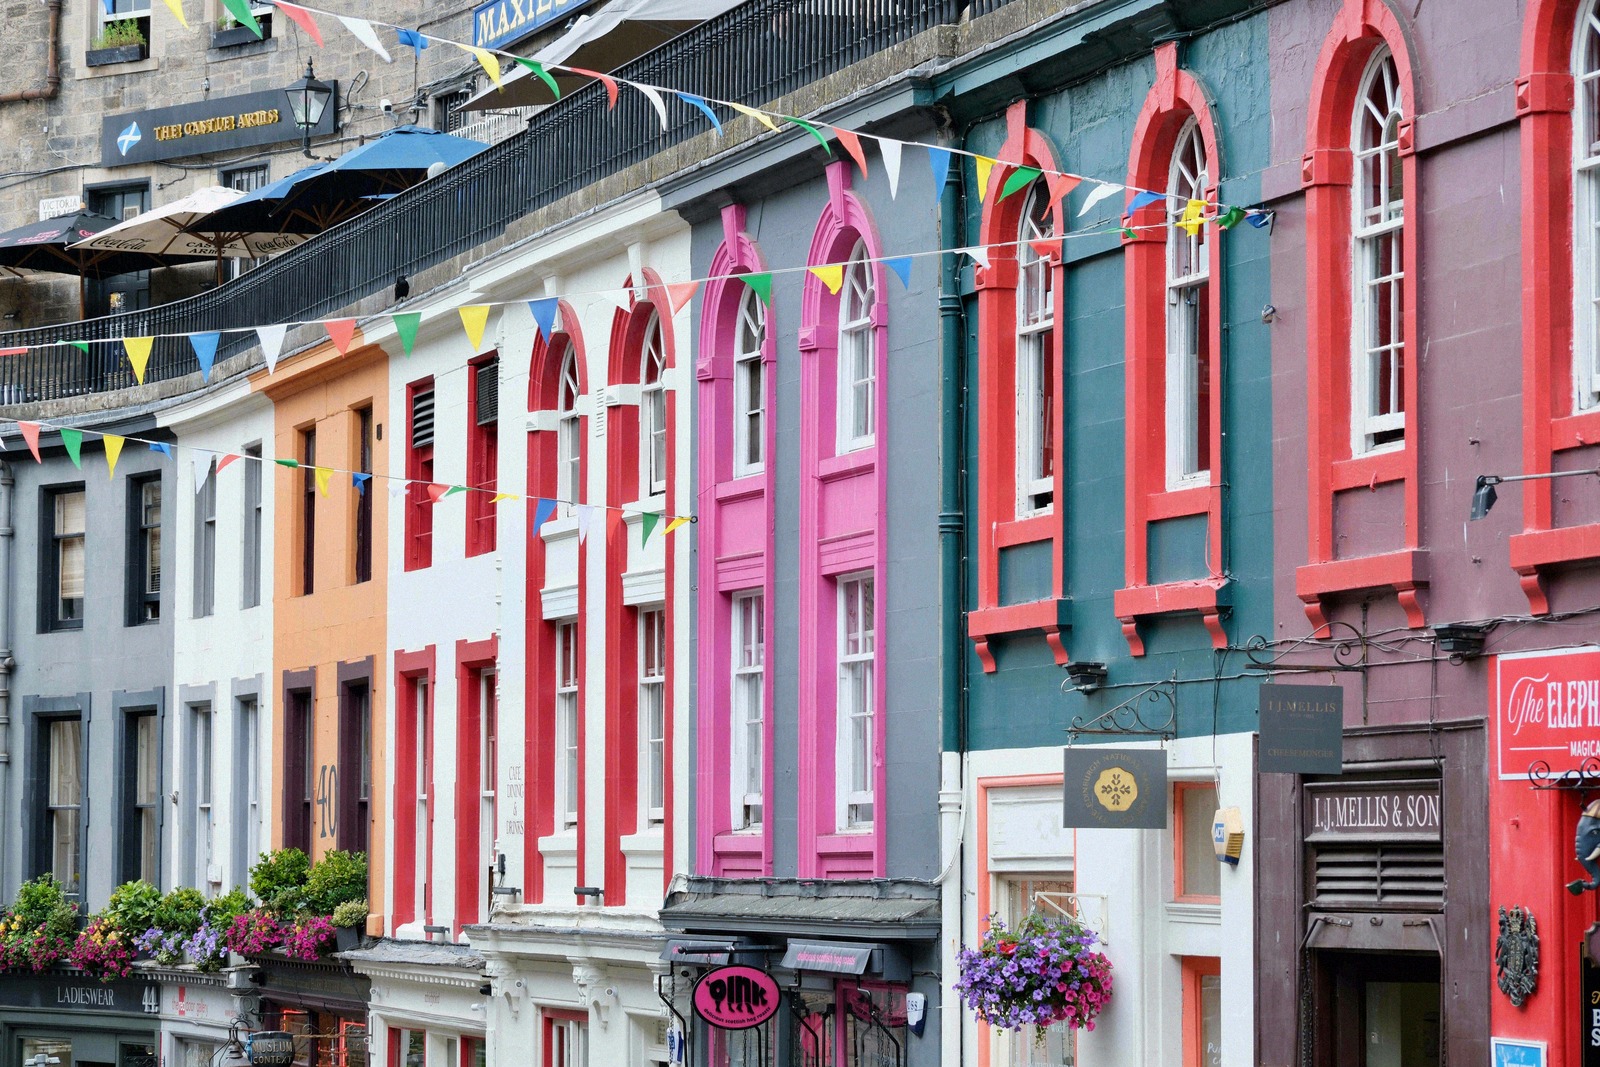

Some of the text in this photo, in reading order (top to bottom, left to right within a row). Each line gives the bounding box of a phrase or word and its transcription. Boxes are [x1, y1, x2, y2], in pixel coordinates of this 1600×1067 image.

[477, 0, 568, 46] MAXIE
[153, 124, 182, 141] THE
[184, 115, 235, 136] CASTLE
[42, 198, 78, 210] VICTORIA
[1508, 672, 1600, 736] The ELEPH
[506, 783, 524, 798] DINING
[316, 764, 338, 838] 40
[512, 801, 518, 816] &
[1392, 795, 1403, 827] &
[1406, 795, 1440, 827] SON
[506, 820, 524, 835] DRINKS
[57, 985, 158, 1013] LADIESWEAR 44
[746, 1015, 757, 1023] hog
[252, 1039, 293, 1053] MUSEUM
[253, 1055, 293, 1065] CONTEXT
